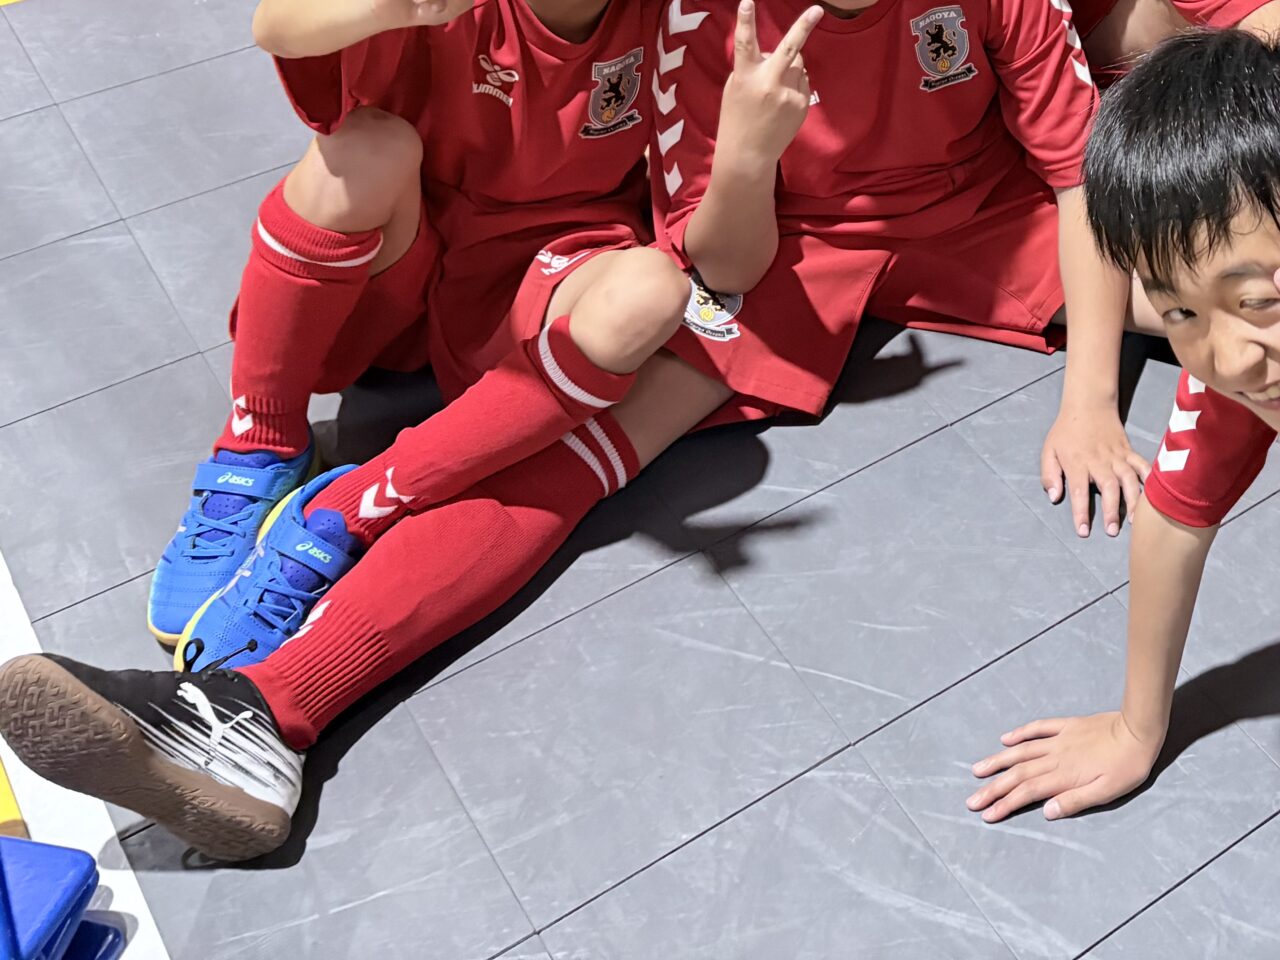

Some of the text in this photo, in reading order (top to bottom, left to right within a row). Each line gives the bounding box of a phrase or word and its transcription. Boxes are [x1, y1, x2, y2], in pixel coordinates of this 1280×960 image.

[919, 11, 957, 28] NAGOYA
[228, 476, 255, 487] asics
[308, 546, 333, 564] asics
